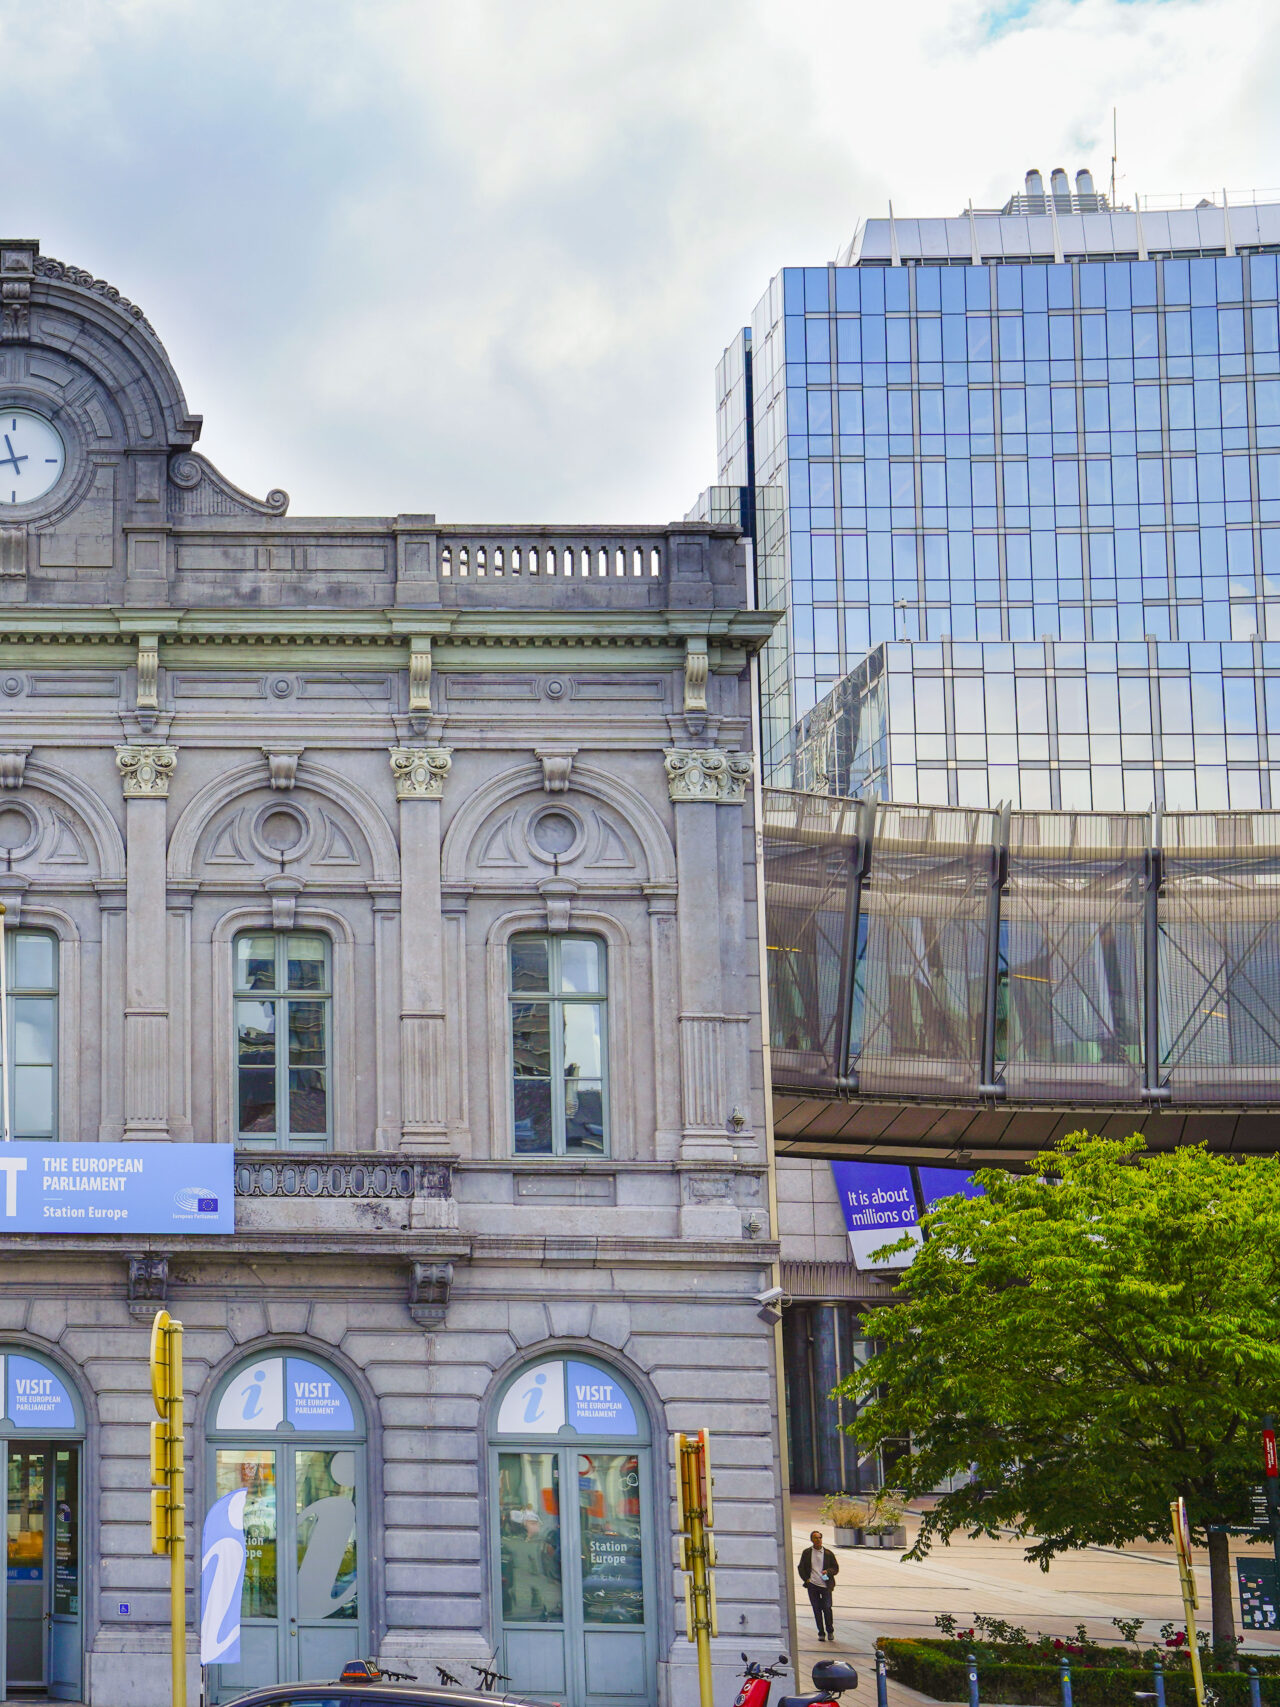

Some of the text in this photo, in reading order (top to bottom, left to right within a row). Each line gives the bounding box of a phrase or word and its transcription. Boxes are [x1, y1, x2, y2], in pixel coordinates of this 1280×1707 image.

[42, 1157, 143, 1173] THE EUROPEAN
[43, 1176, 127, 1191] PARLIAMENT
[847, 1187, 909, 1206] It is about
[43, 1206, 128, 1220] Station Europe
[852, 1208, 899, 1226] millions
[901, 1205, 915, 1222] of
[16, 1379, 52, 1394] VISIT
[294, 1382, 331, 1398] VISIT
[575, 1385, 613, 1401] VISIT
[589, 1402, 622, 1410] EUROPEAN
[576, 1410, 616, 1418] PARLIAMENT
[590, 1540, 628, 1551] Station
[590, 1552, 626, 1565] Europe
